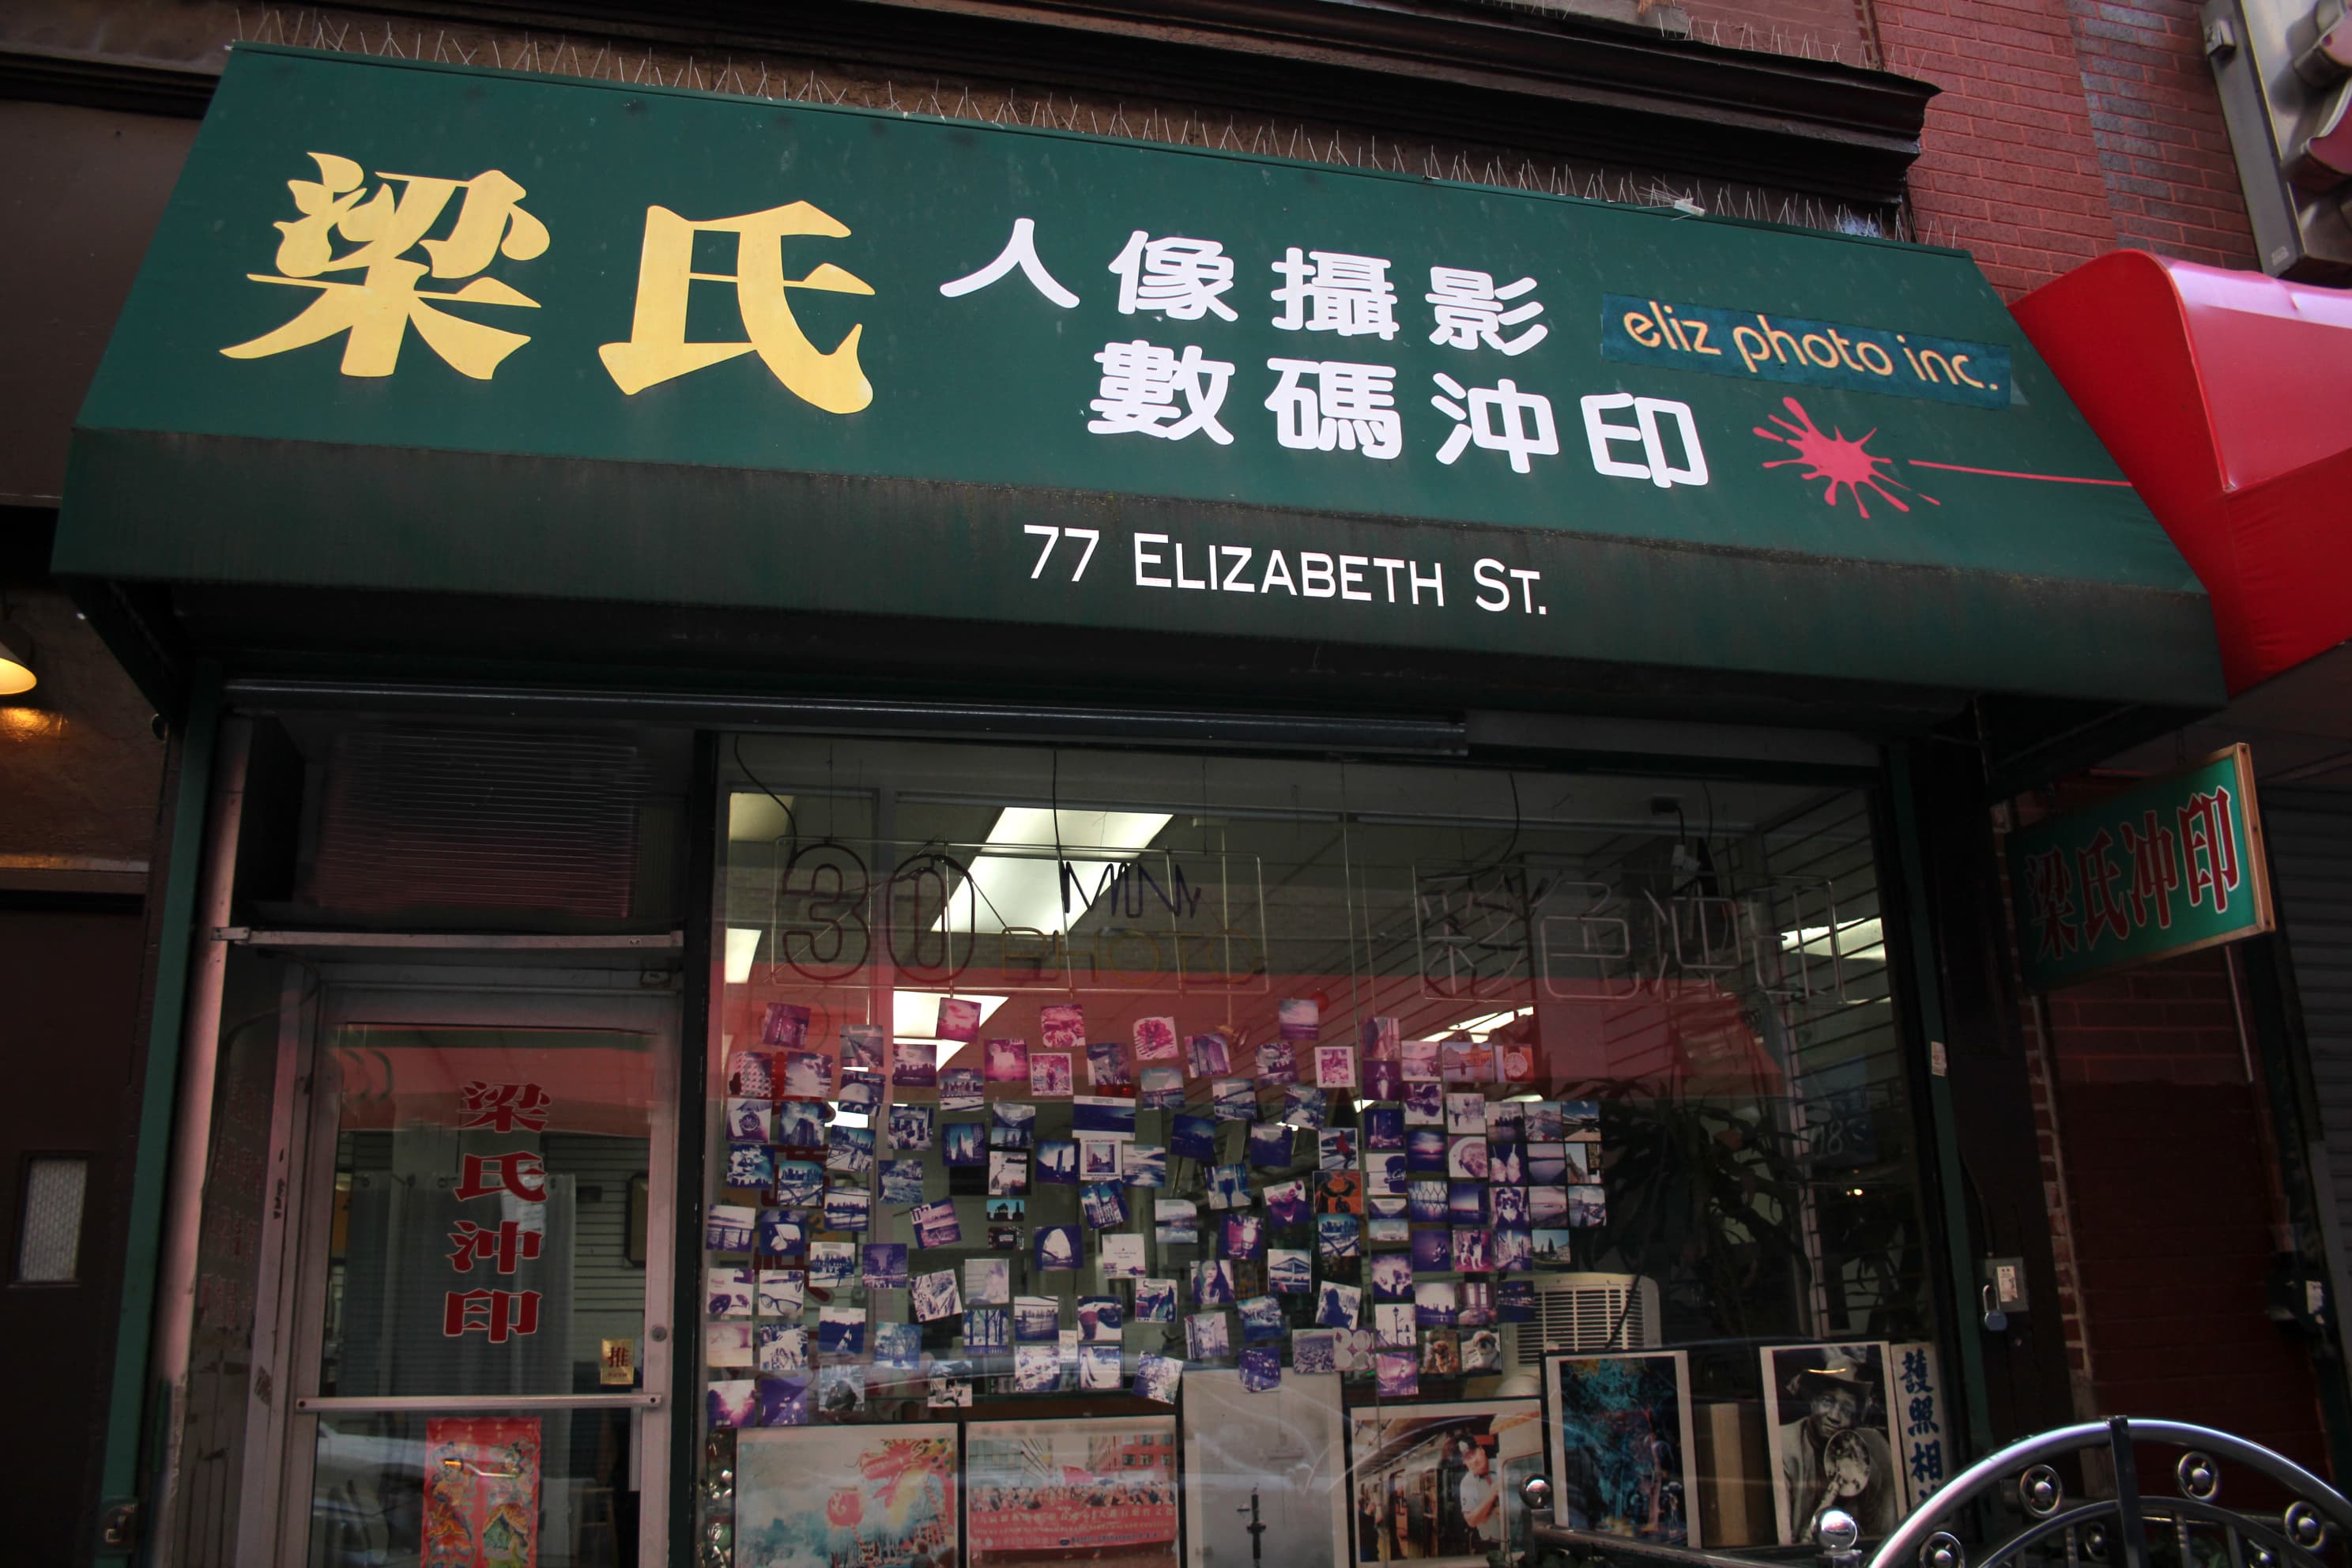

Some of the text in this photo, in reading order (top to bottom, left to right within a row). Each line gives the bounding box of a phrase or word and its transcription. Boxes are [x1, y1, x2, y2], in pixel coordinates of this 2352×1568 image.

[219, 152, 876, 415] 梁氏
[940, 217, 1548, 357] 人像攝影
[1623, 301, 2000, 391] eliz photo inc.
[1087, 339, 1709, 489] 數碼沖印
[1023, 524, 1547, 616] 77 ELIZABETH ST.
[782, 842, 975, 983] 30
[608, 1346, 630, 1368] 推
[1899, 1347, 1946, 1500] 護照相
